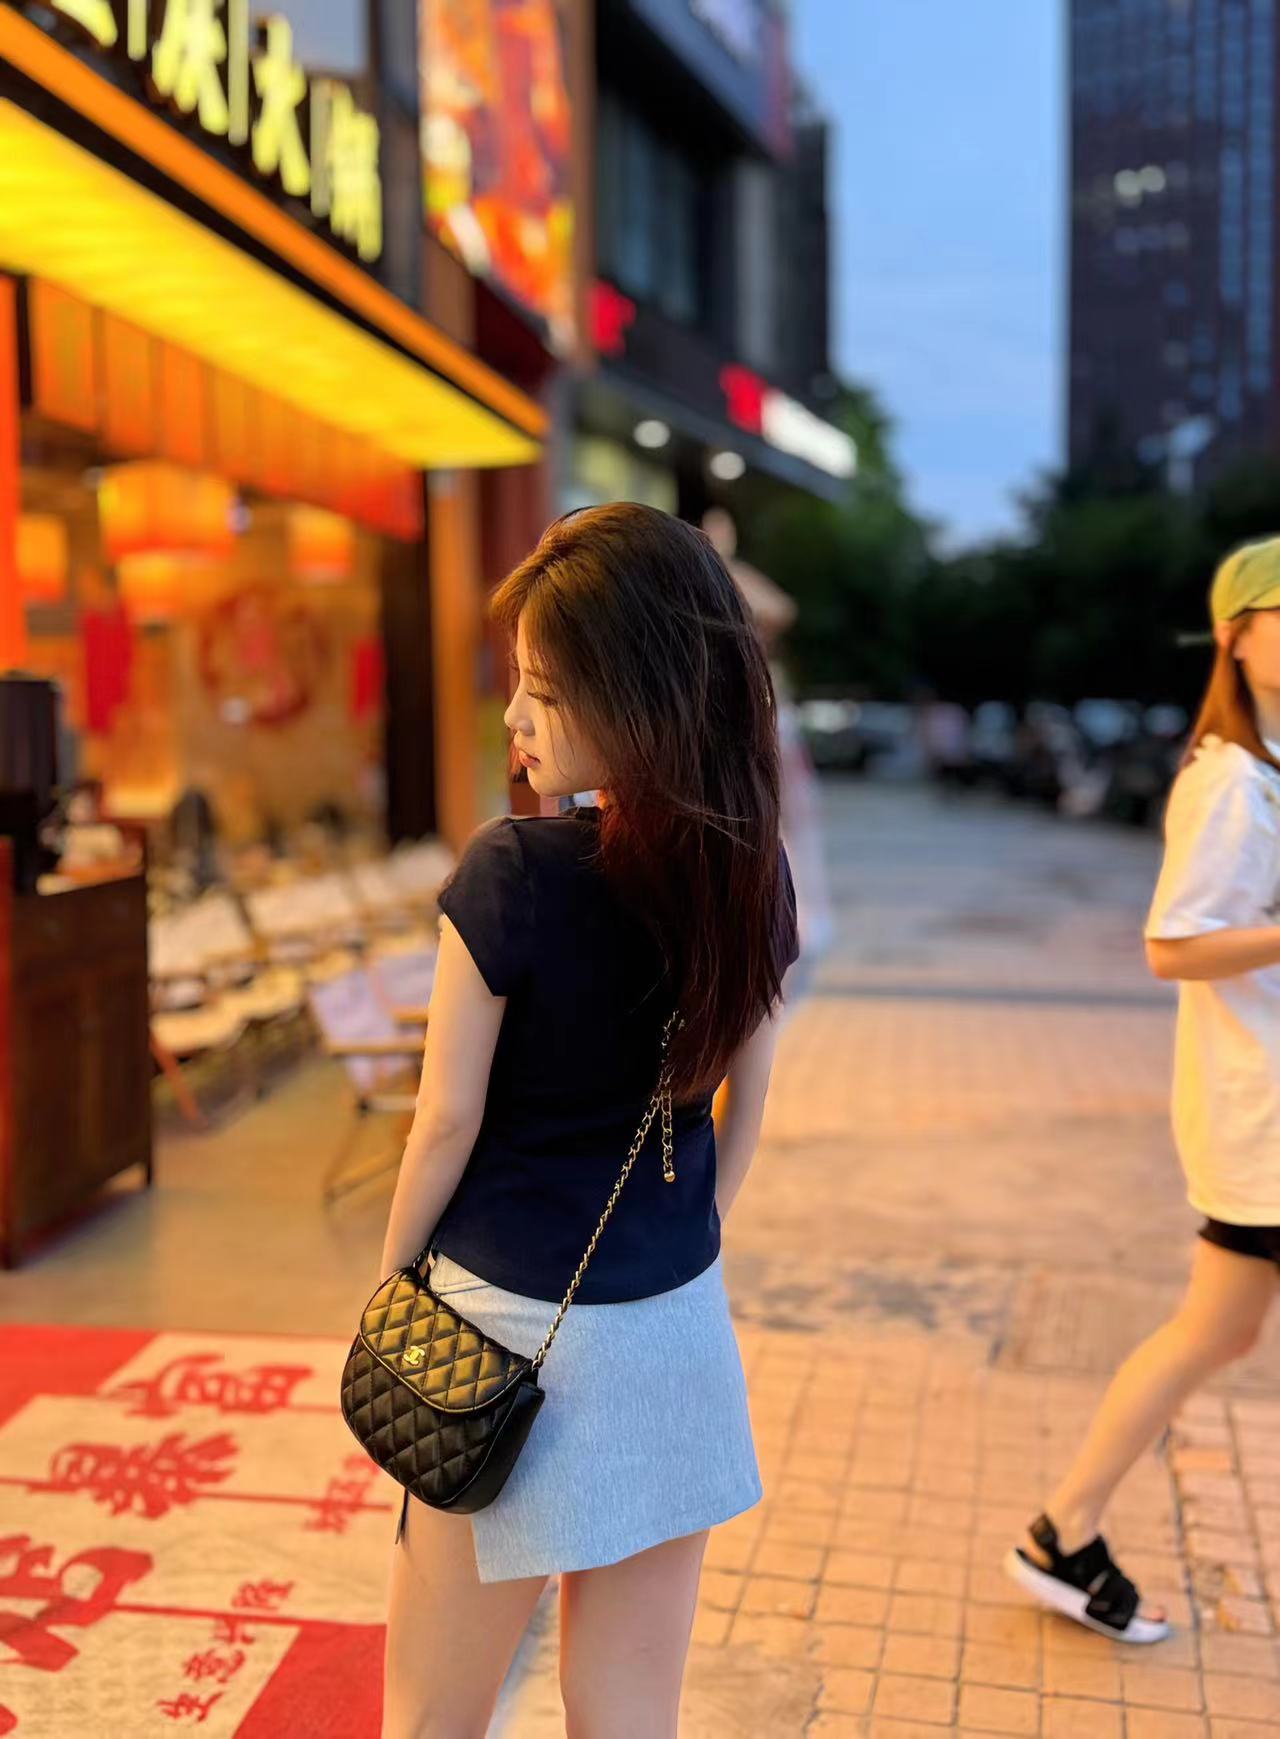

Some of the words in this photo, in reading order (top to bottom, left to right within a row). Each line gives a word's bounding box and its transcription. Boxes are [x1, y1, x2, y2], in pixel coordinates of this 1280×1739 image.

[0, 1353, 316, 1737] 店暴富
[155, 1579, 296, 1722] 生意兴隆
